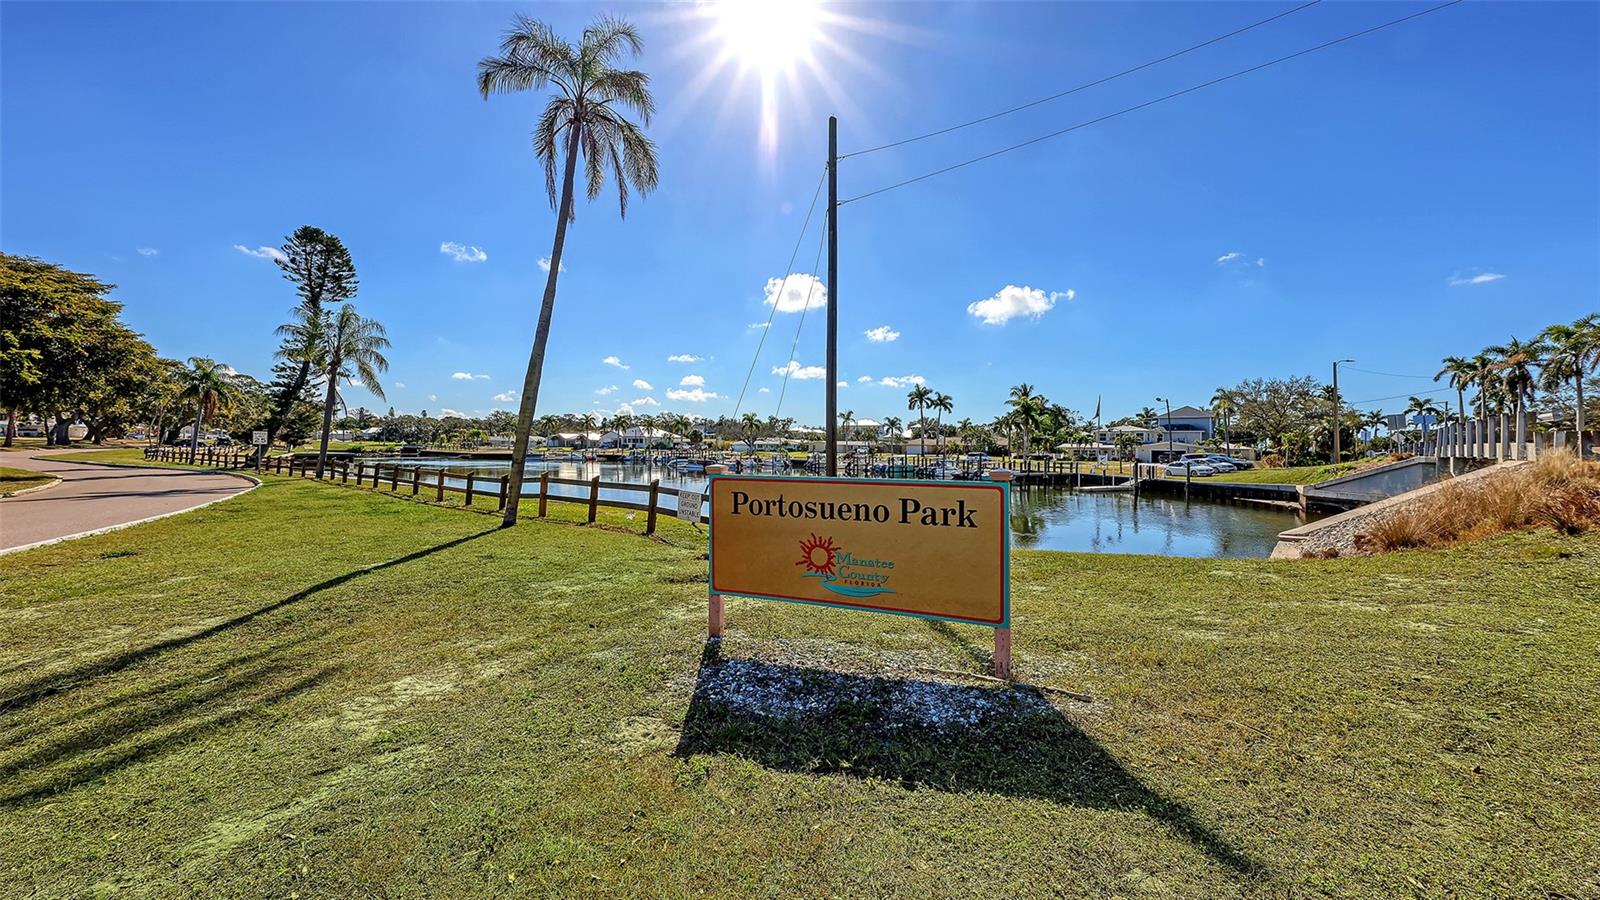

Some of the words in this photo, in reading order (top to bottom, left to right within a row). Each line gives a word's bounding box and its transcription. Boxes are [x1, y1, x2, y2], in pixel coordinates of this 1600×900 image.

[730, 491, 890, 523] Portosueno
[898, 498, 978, 528] Park
[835, 551, 896, 569] Manatee
[837, 565, 889, 584] County
[844, 579, 882, 587] FLORIDA
